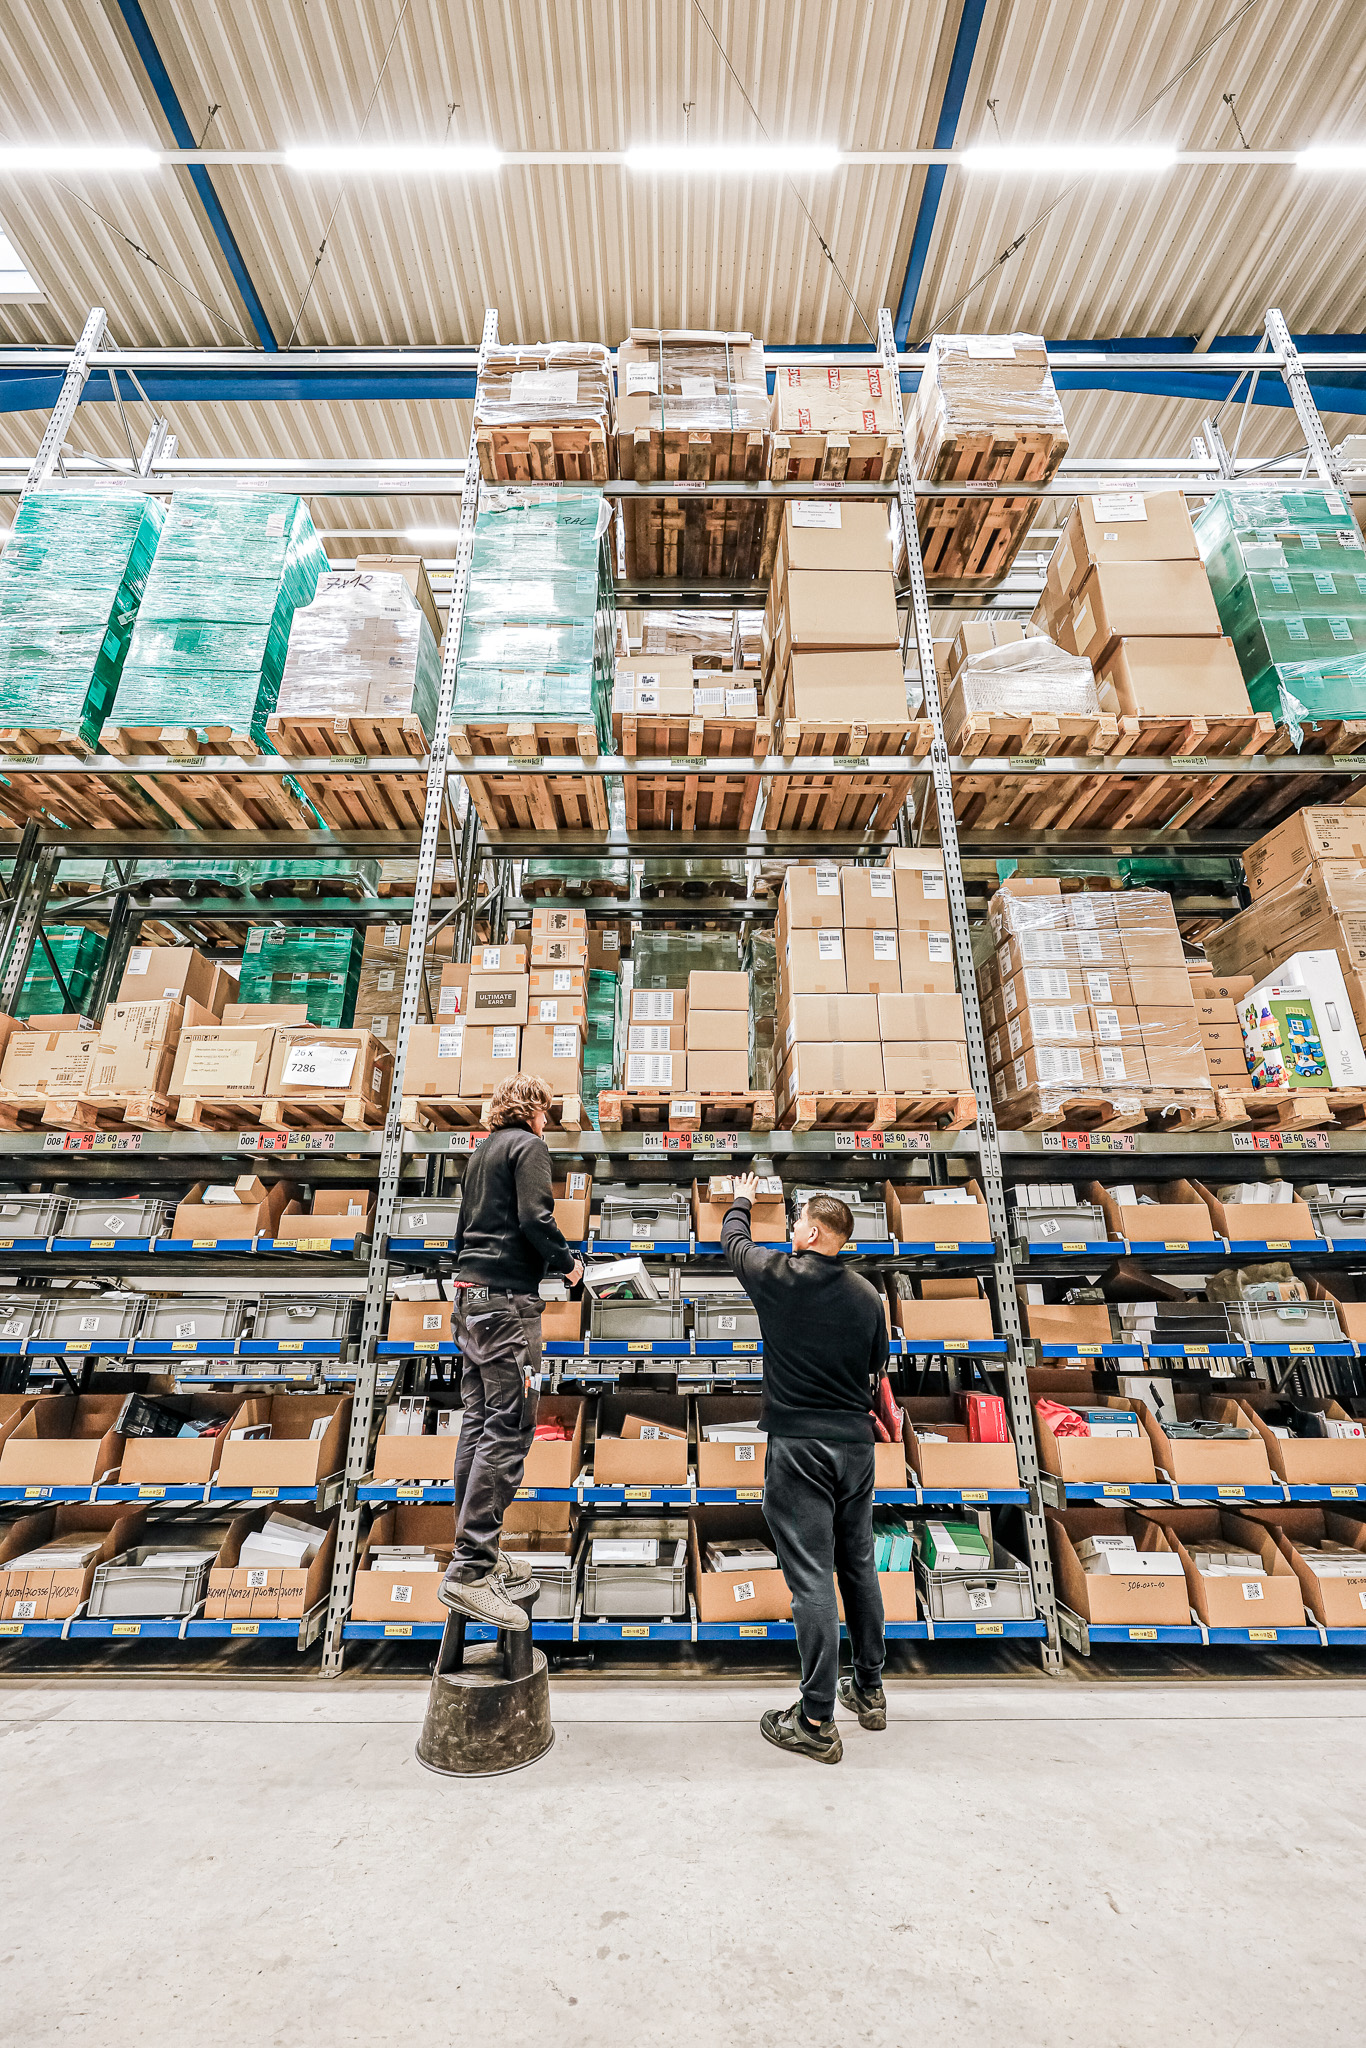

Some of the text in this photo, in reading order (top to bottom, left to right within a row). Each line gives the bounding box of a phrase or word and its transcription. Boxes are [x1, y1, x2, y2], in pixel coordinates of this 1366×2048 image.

[562, 516, 593, 526] PAL
[294, 1049, 306, 1057] 26
[1340, 1049, 1354, 1075] iMac
[291, 1063, 316, 1073] 7286
[83, 1134, 94, 1142] 50
[107, 1134, 118, 1142] 60
[131, 1134, 141, 1142] 70
[277, 1134, 287, 1142] 50
[300, 1134, 311, 1142] 60
[324, 1134, 334, 1142] 70
[680, 1134, 690, 1142] 50
[704, 1134, 714, 1142] 60
[727, 1134, 737, 1142] 70
[872, 1134, 882, 1142] 50
[896, 1134, 906, 1142] 60
[1101, 1135, 1111, 1143] 60
[1124, 1135, 1133, 1143] 70
[1270, 1134, 1280, 1142] 50
